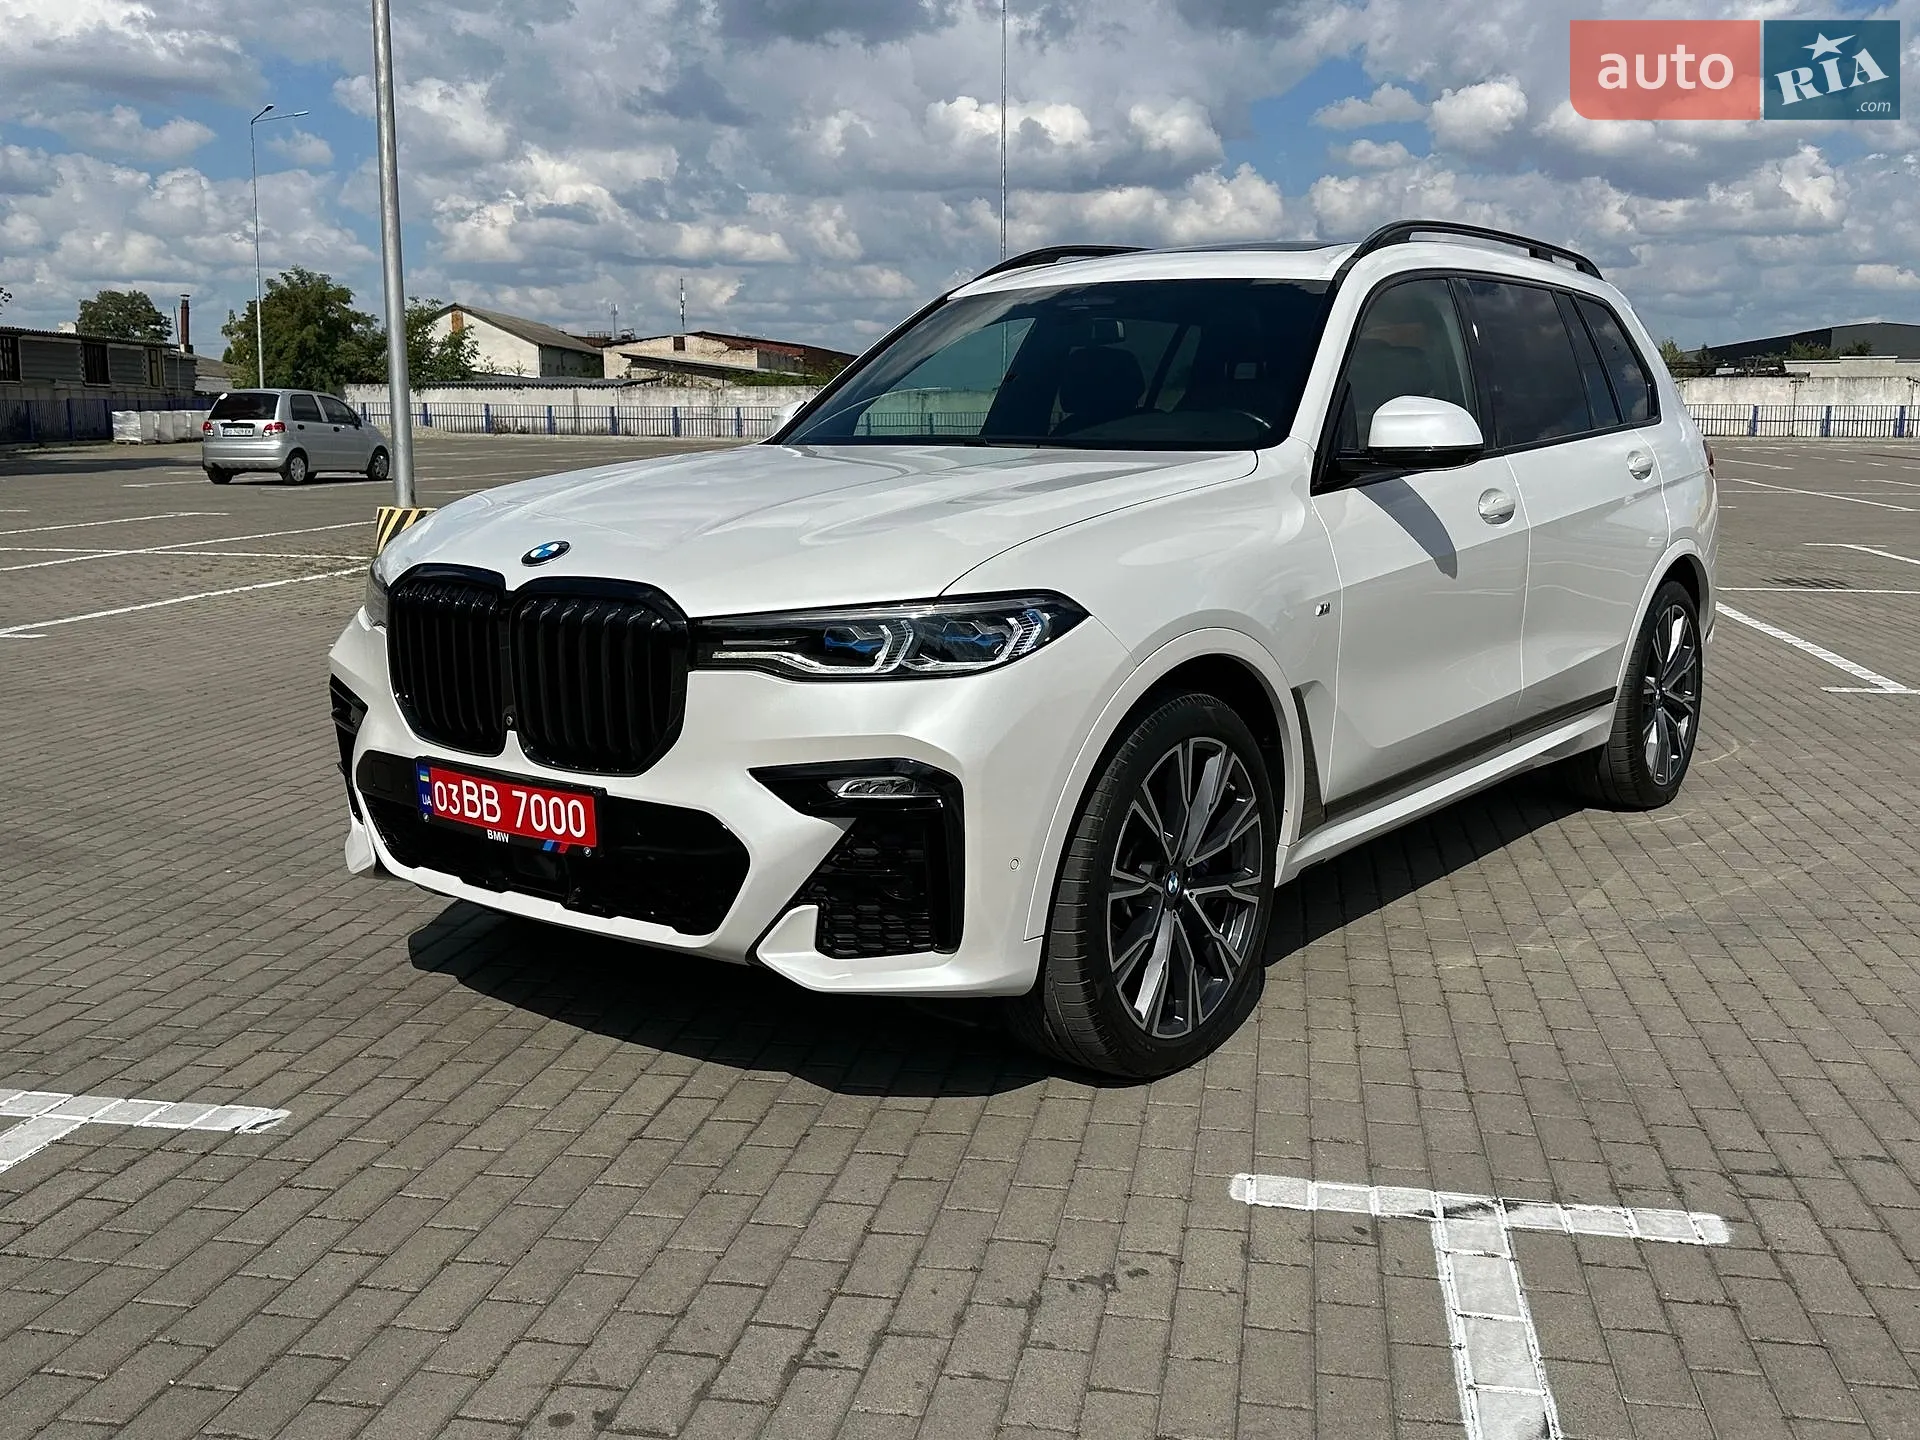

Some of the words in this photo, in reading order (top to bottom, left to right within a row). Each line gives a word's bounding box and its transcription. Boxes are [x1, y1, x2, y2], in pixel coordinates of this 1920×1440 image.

[434, 779, 501, 823] 03BB
[511, 790, 586, 838] 7000
[487, 829, 509, 843] BMW
